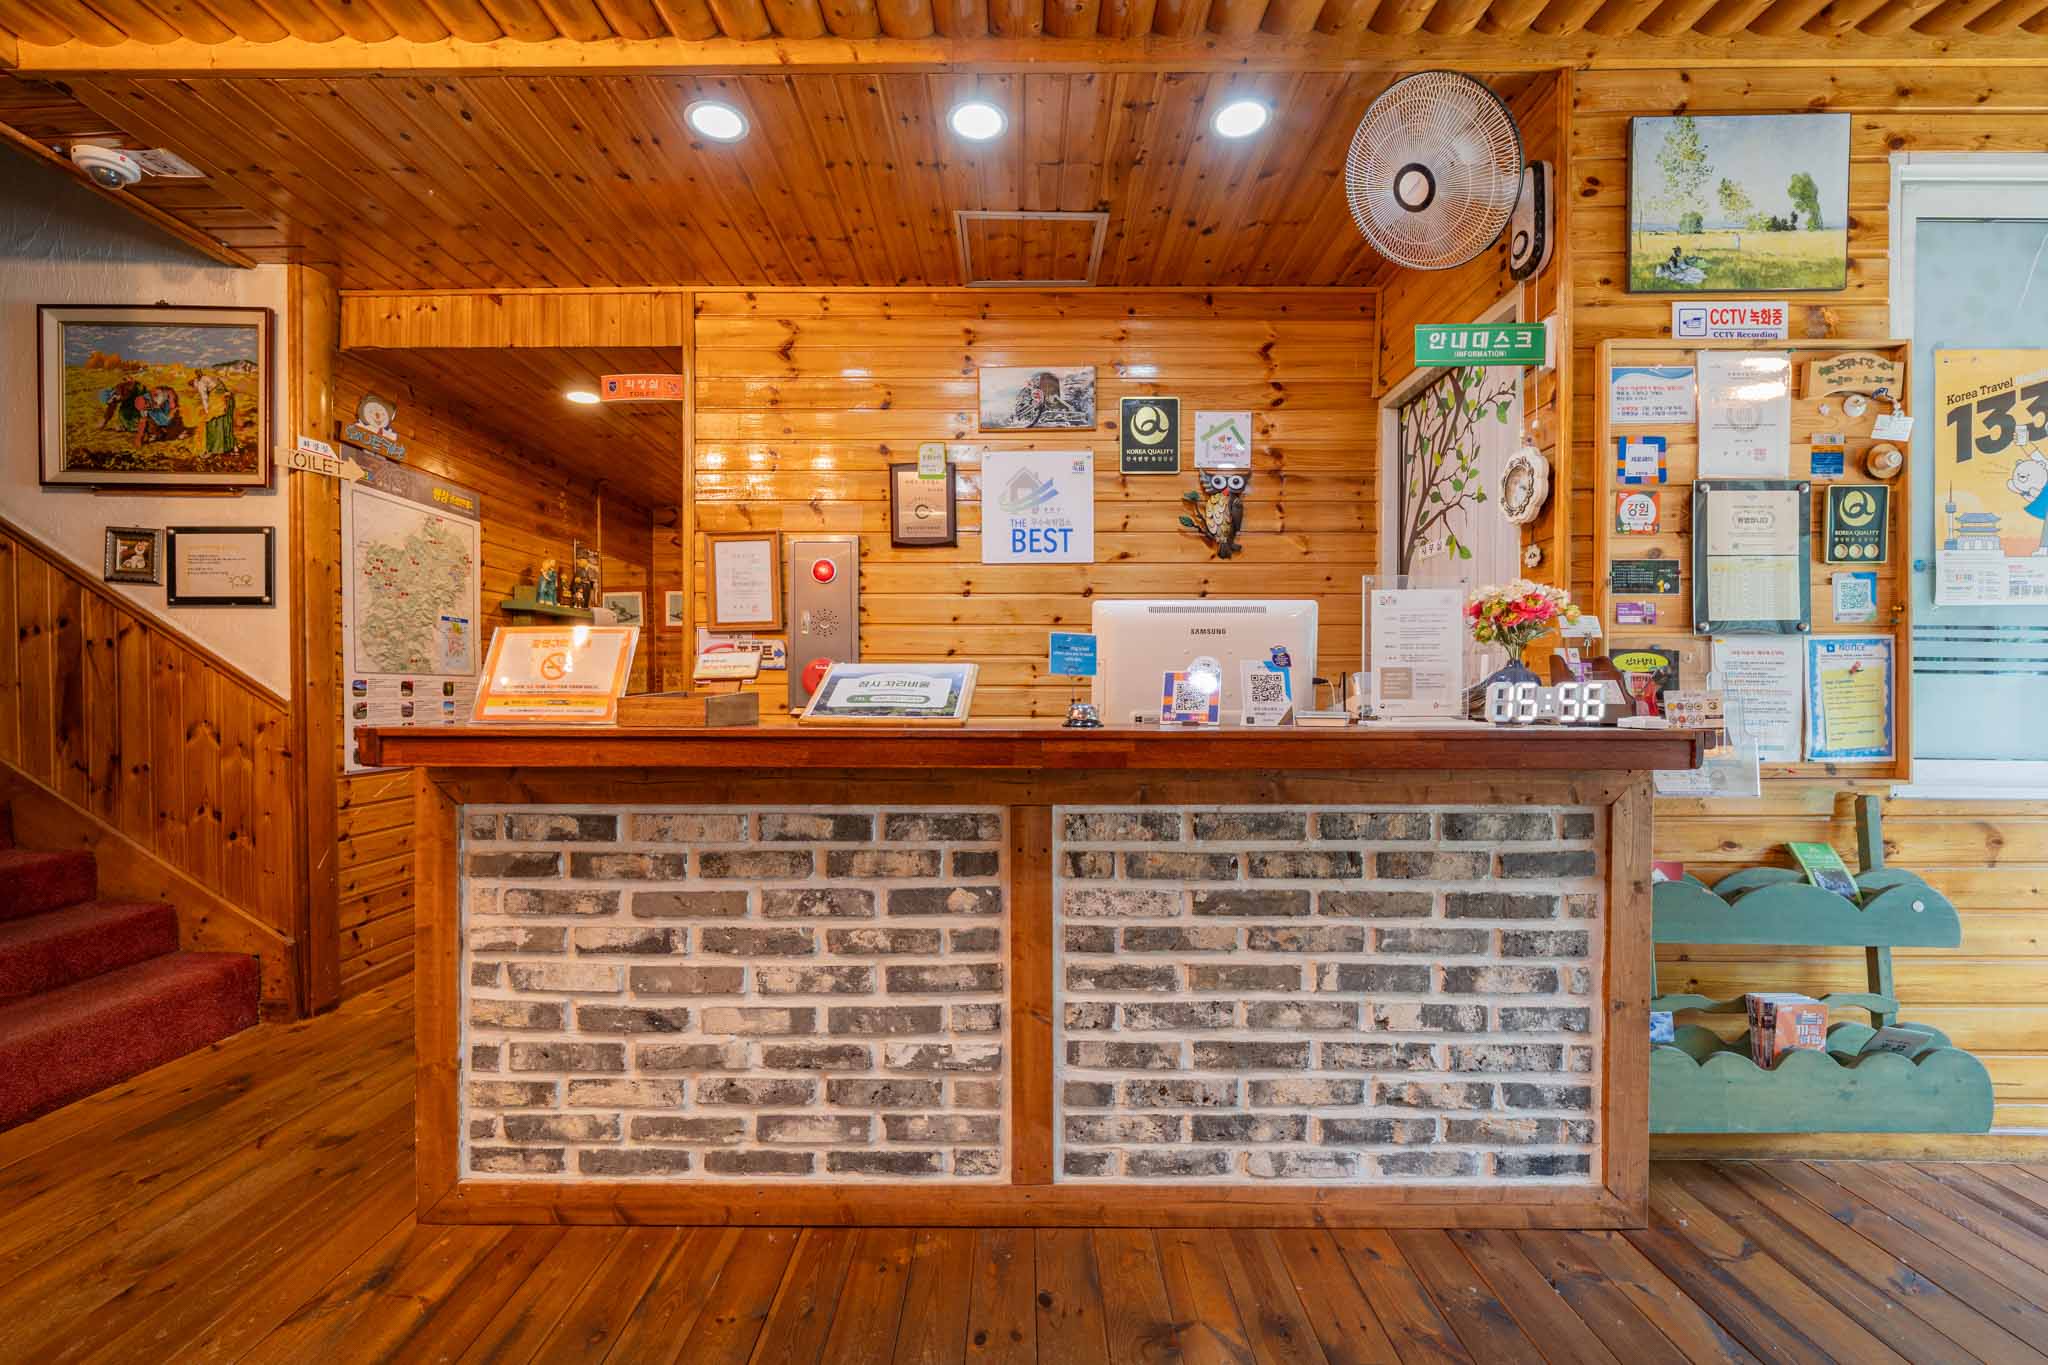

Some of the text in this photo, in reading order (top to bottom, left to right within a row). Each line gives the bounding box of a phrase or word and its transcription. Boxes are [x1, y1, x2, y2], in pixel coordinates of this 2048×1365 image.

[1710, 308, 1783, 326] CCTV 녹화중
[1429, 331, 1532, 349] 안내데스크
[1737, 331, 1778, 339] Recording
[1946, 377, 2014, 406] Korea Travel
[1147, 448, 1174, 456] QUALITY
[1627, 502, 1649, 517] 강원
[1010, 519, 1027, 528] THE
[1012, 528, 1073, 553] BEST
[1507, 682, 1605, 722] 15:56
